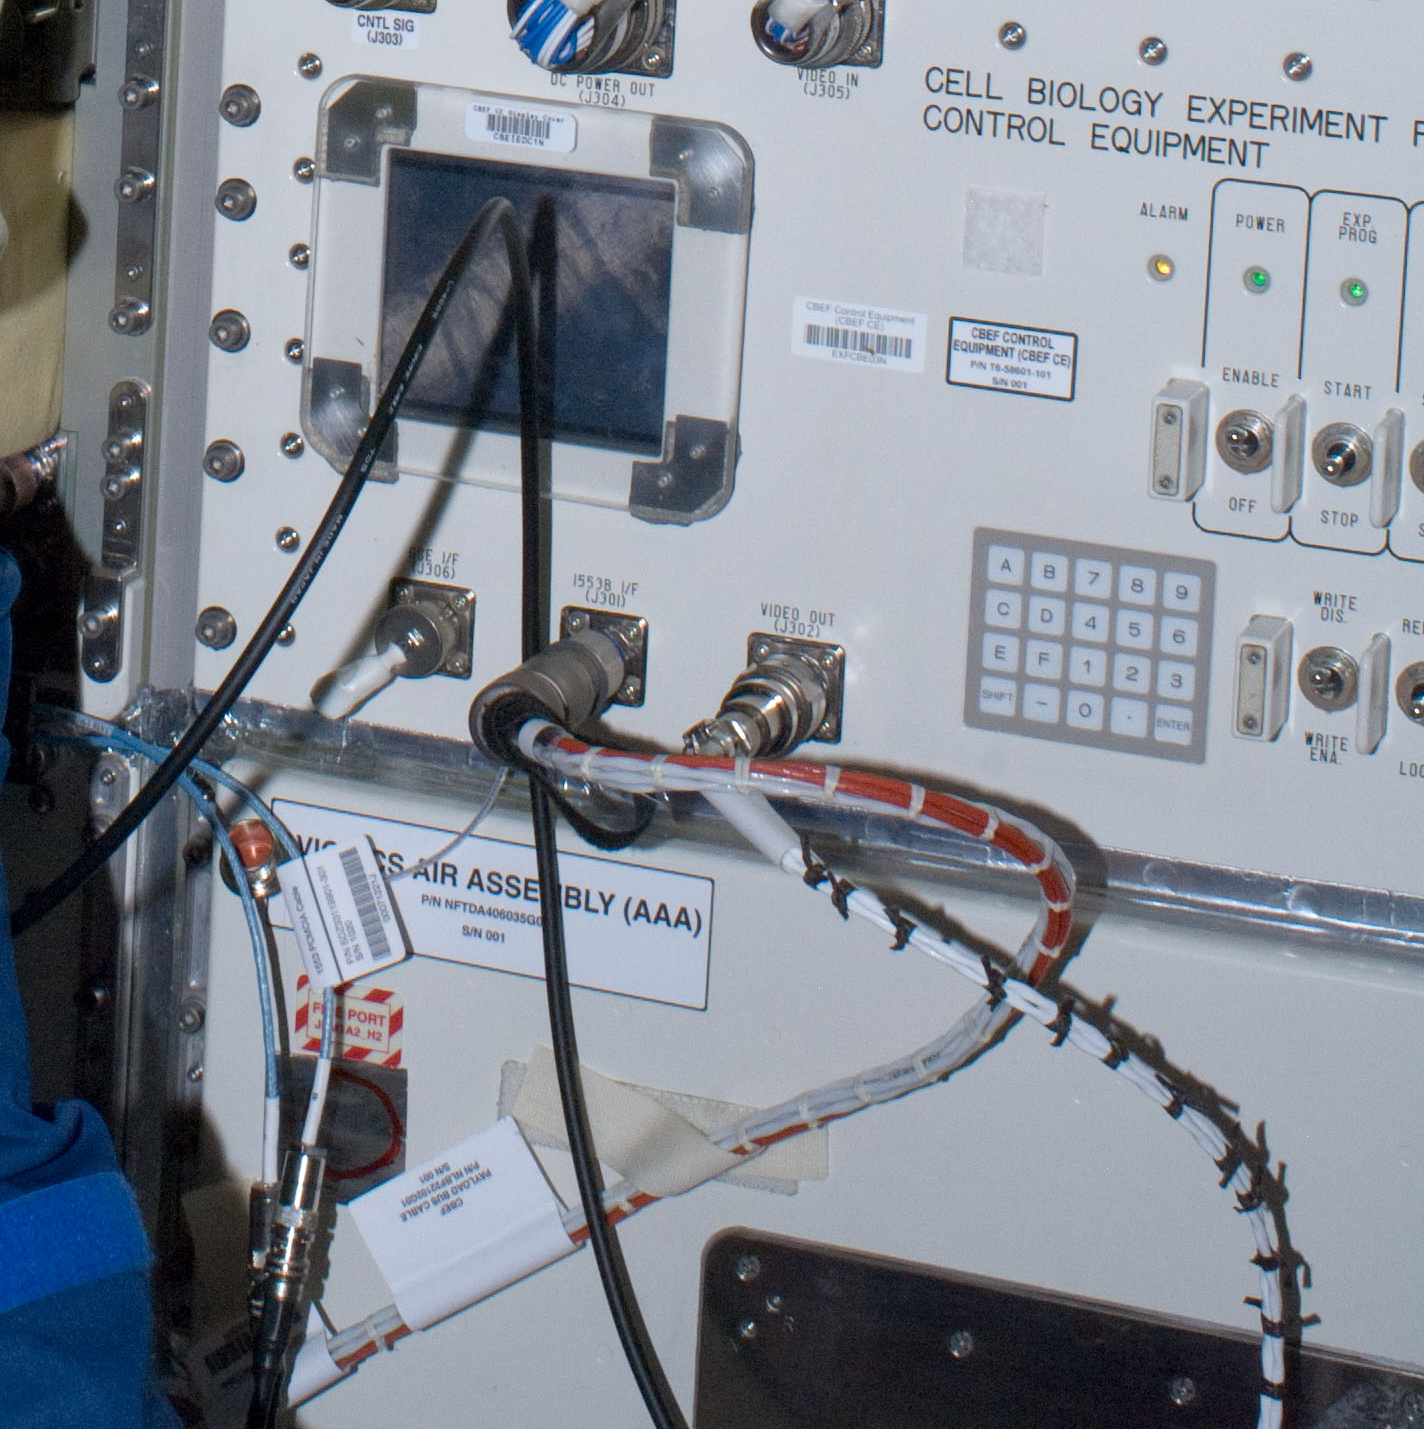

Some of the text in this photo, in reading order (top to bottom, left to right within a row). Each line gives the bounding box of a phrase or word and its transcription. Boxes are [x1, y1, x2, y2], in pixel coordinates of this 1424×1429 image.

[357, 14, 415, 33] CNTL SIG
[367, 30, 404, 47] (J303)
[576, 75, 621, 94] POWER
[629, 80, 656, 98] OUT
[797, 70, 859, 88] VIDEO IN
[579, 89, 626, 108] (J304)
[803, 82, 851, 100] (J305)
[924, 66, 1003, 101] CELL
[1027, 77, 1165, 119] BIOLOGY
[1187, 94, 1388, 143] EXPERIMENT
[923, 104, 1270, 169] CONTROL EQUIPMENT
[1139, 201, 1189, 222] ALARM
[1235, 213, 1286, 234] POWER
[1338, 226, 1378, 244] PROG
[834, 305, 866, 318] Control
[868, 309, 915, 326] Equipment
[971, 326, 1055, 350] CBEF CONTROL
[952, 339, 1072, 369] EQUIPMENT (CBEF CE)
[1010, 378, 1028, 389] 001
[1222, 366, 1280, 388] ENABLE
[1323, 380, 1372, 400] START
[1228, 497, 1257, 515] OFF
[1320, 509, 1359, 528] STOP
[1000, 558, 1012, 573] A
[1043, 564, 1056, 580] B
[1087, 571, 1100, 586] 7
[1130, 578, 1144, 593] 8
[585, 589, 626, 610] (J301)
[1175, 584, 1189, 600] 9
[1313, 590, 1357, 612] WRITE
[761, 601, 836, 627] VIDEO OUT
[997, 601, 1010, 617] C
[1040, 608, 1053, 623] D
[1320, 604, 1349, 624] DIS.
[773, 619, 821, 639] (J302)
[1084, 615, 1097, 630] 4
[1128, 622, 1141, 637] 5
[1172, 629, 1186, 645] 6
[994, 645, 1007, 661] E
[1038, 651, 1050, 666] F
[1083, 659, 1091, 674] 1
[1125, 666, 1139, 682] 2
[1170, 673, 1183, 689] 3
[982, 689, 1014, 703] SHIFT
[1156, 718, 1190, 732] ENTER
[1304, 730, 1348, 753] WRITE
[1310, 746, 1342, 766] ENA.
[412, 857, 703, 939] AIR ASSEBLY (AAA)
[421, 894, 442, 910] P/N
[462, 925, 506, 944] S/N 001
[347, 1006, 387, 1028] PORT
[399, 1167, 493, 1222] PAYLOAD BUS CABLE
